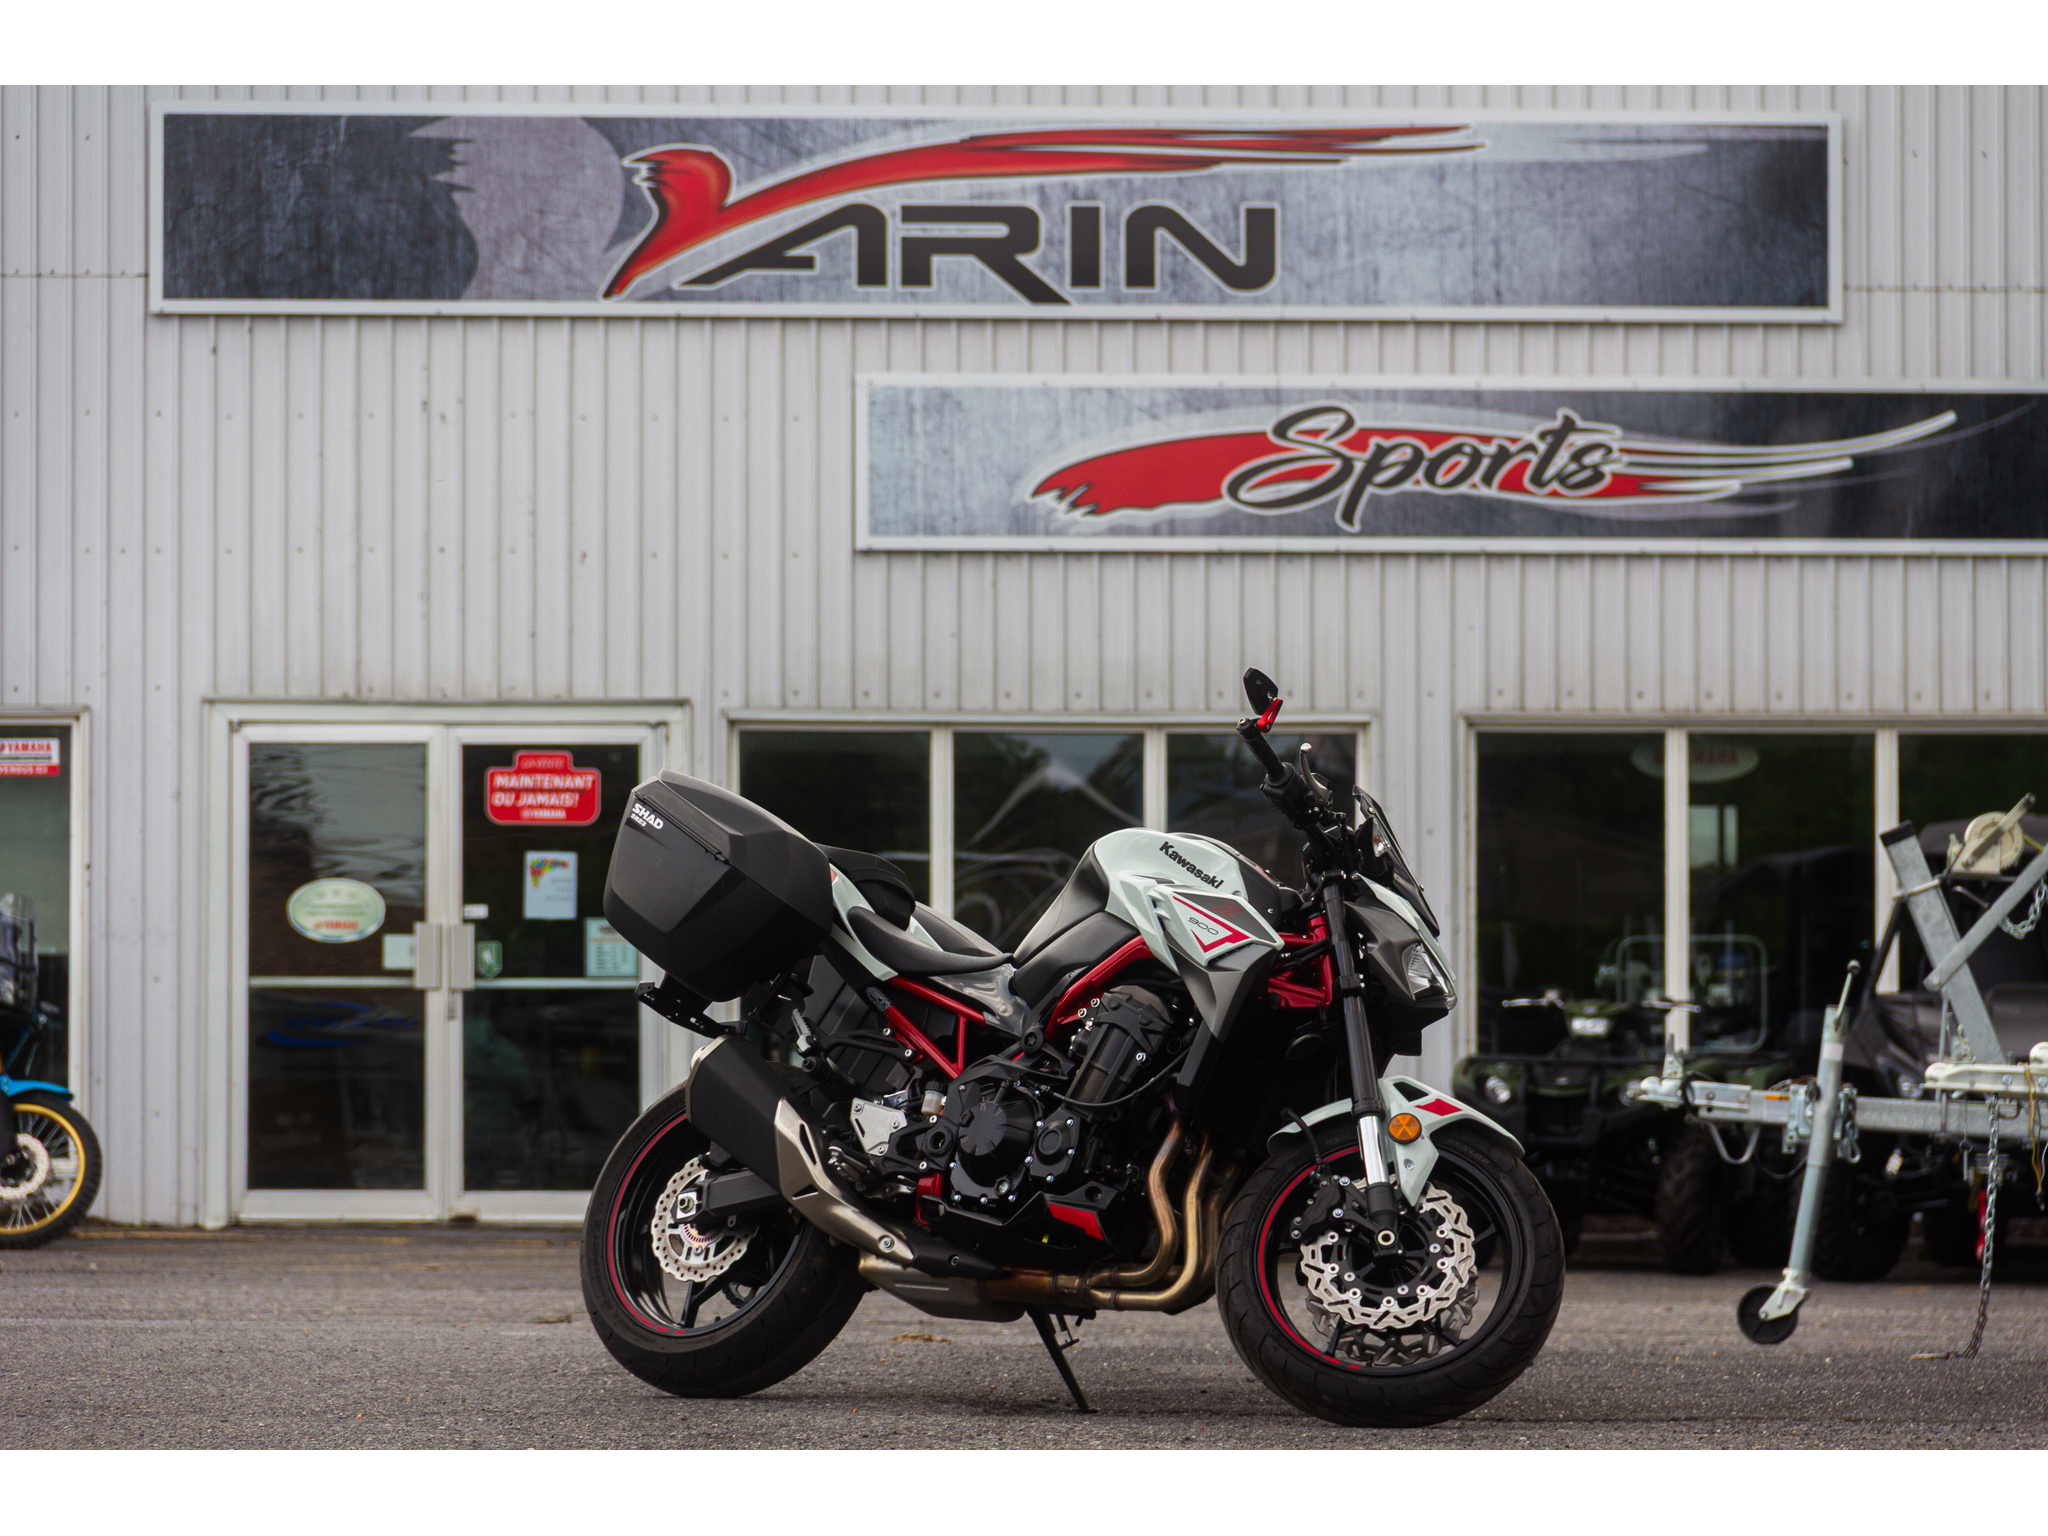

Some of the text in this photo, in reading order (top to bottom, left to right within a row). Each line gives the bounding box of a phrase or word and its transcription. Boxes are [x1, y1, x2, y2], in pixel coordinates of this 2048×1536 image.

[1226, 406, 1623, 528] Sports
[7, 742, 52, 753] YAMAHA
[494, 774, 595, 789] MAINTENANT
[492, 792, 579, 807] OU JAMAIS!
[632, 803, 664, 829] SHAD
[1159, 841, 1225, 889] Kawasaki
[1187, 917, 1219, 936] 900
